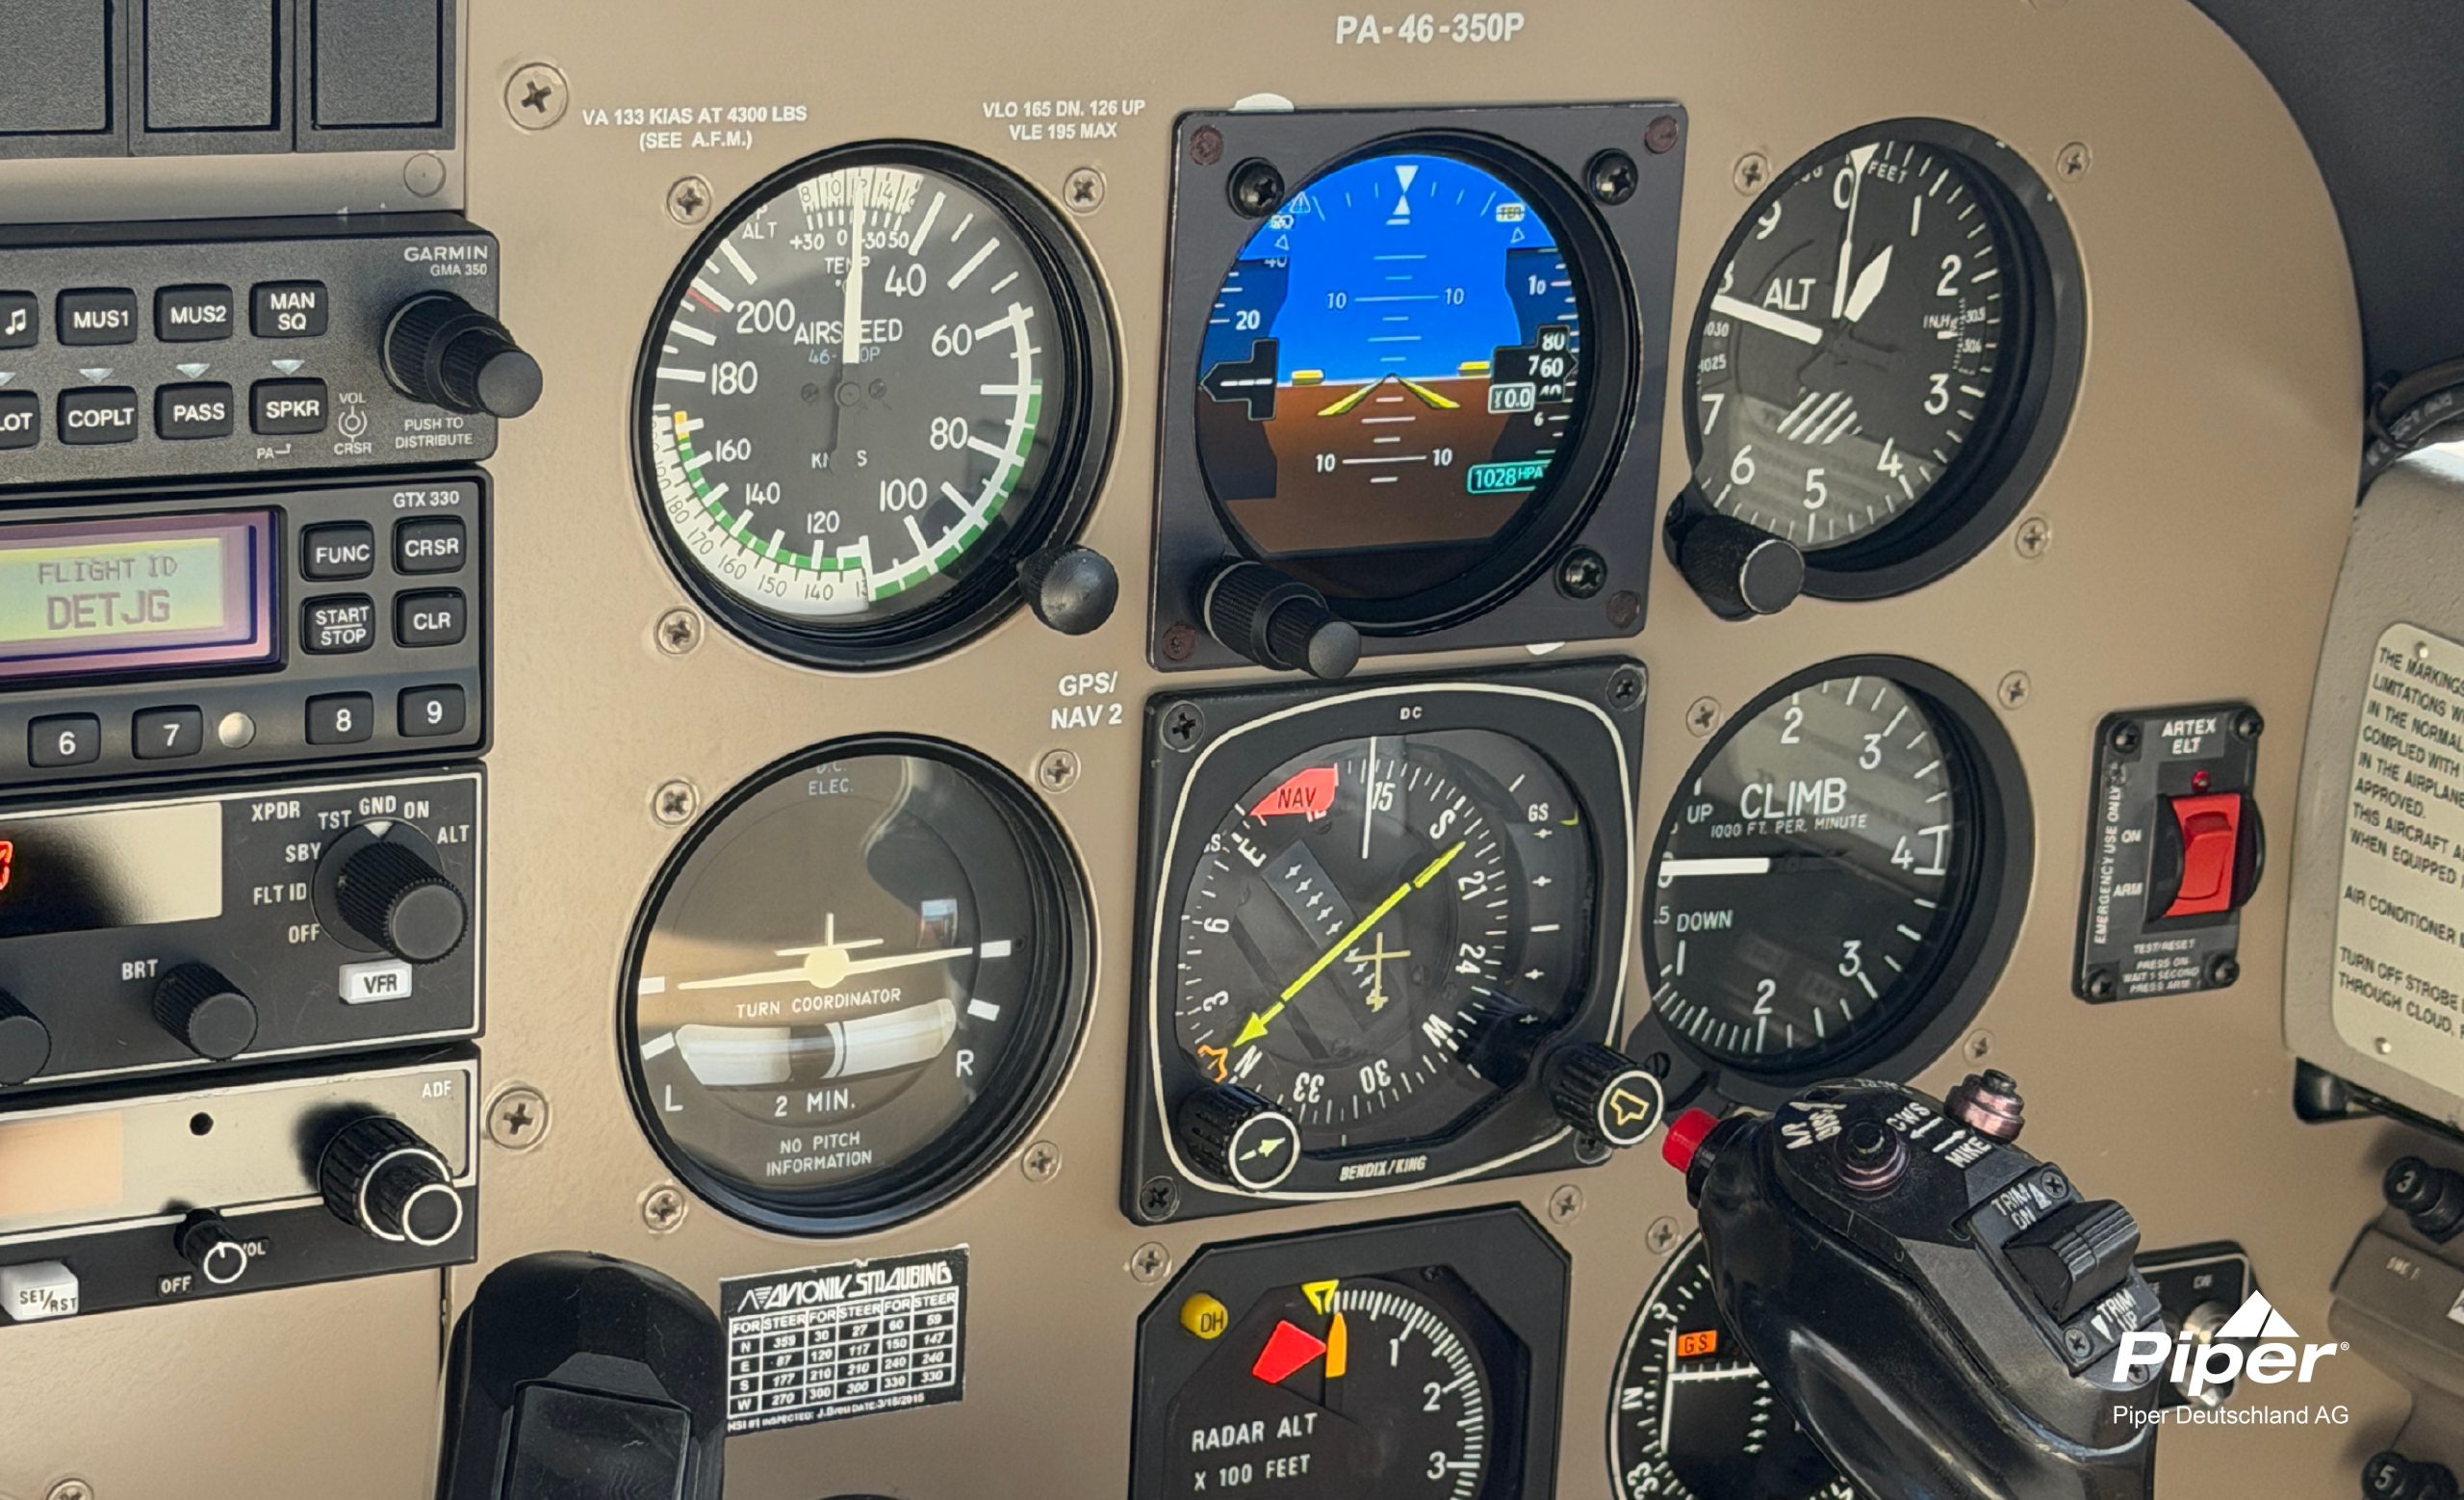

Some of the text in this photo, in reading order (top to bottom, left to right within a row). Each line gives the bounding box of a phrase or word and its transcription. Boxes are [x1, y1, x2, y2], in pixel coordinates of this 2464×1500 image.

[582, 105, 808, 126] VA 133 KIAS AT 4300 LBS
[983, 99, 1146, 118] VLO 165 DN. 126 UP
[639, 130, 754, 151] (SEE A.F.M.)
[1009, 122, 1118, 141] VLE 195 MAX
[1867, 162, 1909, 184] FEET
[742, 221, 778, 239] ALT
[403, 245, 488, 263] GARMIN
[430, 263, 488, 276] GMA 350
[885, 263, 926, 297] 40
[270, 292, 316, 310] MAN
[1327, 292, 1347, 309] 10
[1445, 289, 1465, 306] 10
[1763, 278, 1816, 310] ALT
[73, 311, 129, 329] MUS1
[170, 306, 227, 324] MUS2
[277, 314, 307, 331] SQ
[736, 298, 795, 333] 200
[1236, 310, 1260, 331] 20
[794, 319, 903, 345] AIRSEED
[932, 328, 972, 357] 60
[1542, 333, 1565, 351] 80
[712, 362, 757, 395] 180
[339, 393, 366, 404] VOL
[68, 408, 135, 427] COPLT
[173, 403, 225, 422] PASS
[266, 400, 320, 419] SPKR
[404, 417, 464, 431] PUSH TO
[931, 418, 967, 451] 80
[334, 441, 372, 455] CRSR
[395, 432, 474, 450] DISTRIBUTE
[716, 438, 752, 462] 160
[257, 447, 274, 460] PA
[1316, 454, 1336, 472] 10
[1432, 448, 1452, 466] 10
[393, 490, 460, 508] GTX 330
[746, 481, 781, 505] 140
[880, 478, 927, 511] 100
[808, 510, 840, 533] 120
[316, 544, 371, 563] FUNC
[405, 538, 459, 557] CRSR
[38, 555, 177, 584] FLIGHT ID
[46, 589, 171, 631] DETJG
[316, 605, 370, 626] START
[413, 611, 450, 631] CLR
[321, 628, 367, 646] STOP
[2379, 647, 2402, 670] THE
[1059, 671, 1117, 696] GPS/
[2373, 673, 2446, 717] LIMITATIONS
[1051, 705, 1103, 729] NAV
[1400, 707, 1422, 719] DC
[2367, 700, 2408, 730] IN THE
[2162, 717, 2217, 737] ARTEX
[2172, 737, 2201, 755] ELT
[2363, 725, 2459, 778] COMPLIED WITH
[2358, 751, 2400, 782] IN THE
[359, 796, 397, 815] GND
[1278, 787, 1316, 809] NAV
[1372, 781, 1396, 812] 15
[1740, 777, 1847, 819] CLIMB
[251, 801, 300, 821] XPDR
[403, 800, 429, 818] ON
[1528, 803, 1549, 821] GS
[1686, 803, 1713, 824] UP
[318, 810, 351, 830] TST
[1710, 814, 1868, 839] 1000 MINUTE
[2352, 802, 2380, 827] THIS
[2384, 816, 2450, 855] AIRCRAFT
[437, 825, 469, 844] ALT
[2121, 829, 2142, 842] ON
[285, 842, 321, 863] SBY
[2349, 829, 2388, 858] WHEN
[2392, 845, 2457, 885] EQUIPPED
[2094, 786, 2122, 944] EMERGENCY USE ONLY
[253, 883, 307, 905] FLT ID
[2113, 882, 2143, 897] ARM
[1676, 909, 1733, 932] DOWN
[2344, 885, 2367, 908] AIR
[2369, 894, 2455, 945] CONDITIONER
[289, 924, 321, 943] OFF
[121, 959, 159, 980] BRT
[2339, 945, 2459, 1012] TURN OFF STROBE
[364, 973, 398, 994] VFR
[2338, 971, 2402, 1013] THROUGH
[736, 988, 902, 1019] TURN COORDINATOR
[422, 1080, 452, 1099] ADF
[808, 1088, 856, 1113] MIN.
[1886, 1102, 1932, 1131] CWS
[780, 1131, 860, 1153] NO PITCH
[1945, 1136, 1992, 1169] MIKE
[767, 1150, 872, 1177] INFORMATION
[1341, 1155, 1427, 1181] BENDIX/KING
[161, 1276, 192, 1294] OFF
[732, 1292, 956, 1334] FOR STEER FOR STEER FOR STEER
[1200, 1311, 1224, 1333] DH
[852, 1325, 867, 1336] 27
[1684, 1334, 1708, 1354] GS
[811, 1350, 833, 1361] 120
[810, 1368, 832, 1381] 210
[1192, 1412, 1318, 1452] RADAR ALT
[1219, 1454, 1311, 1487] 100 FEET
